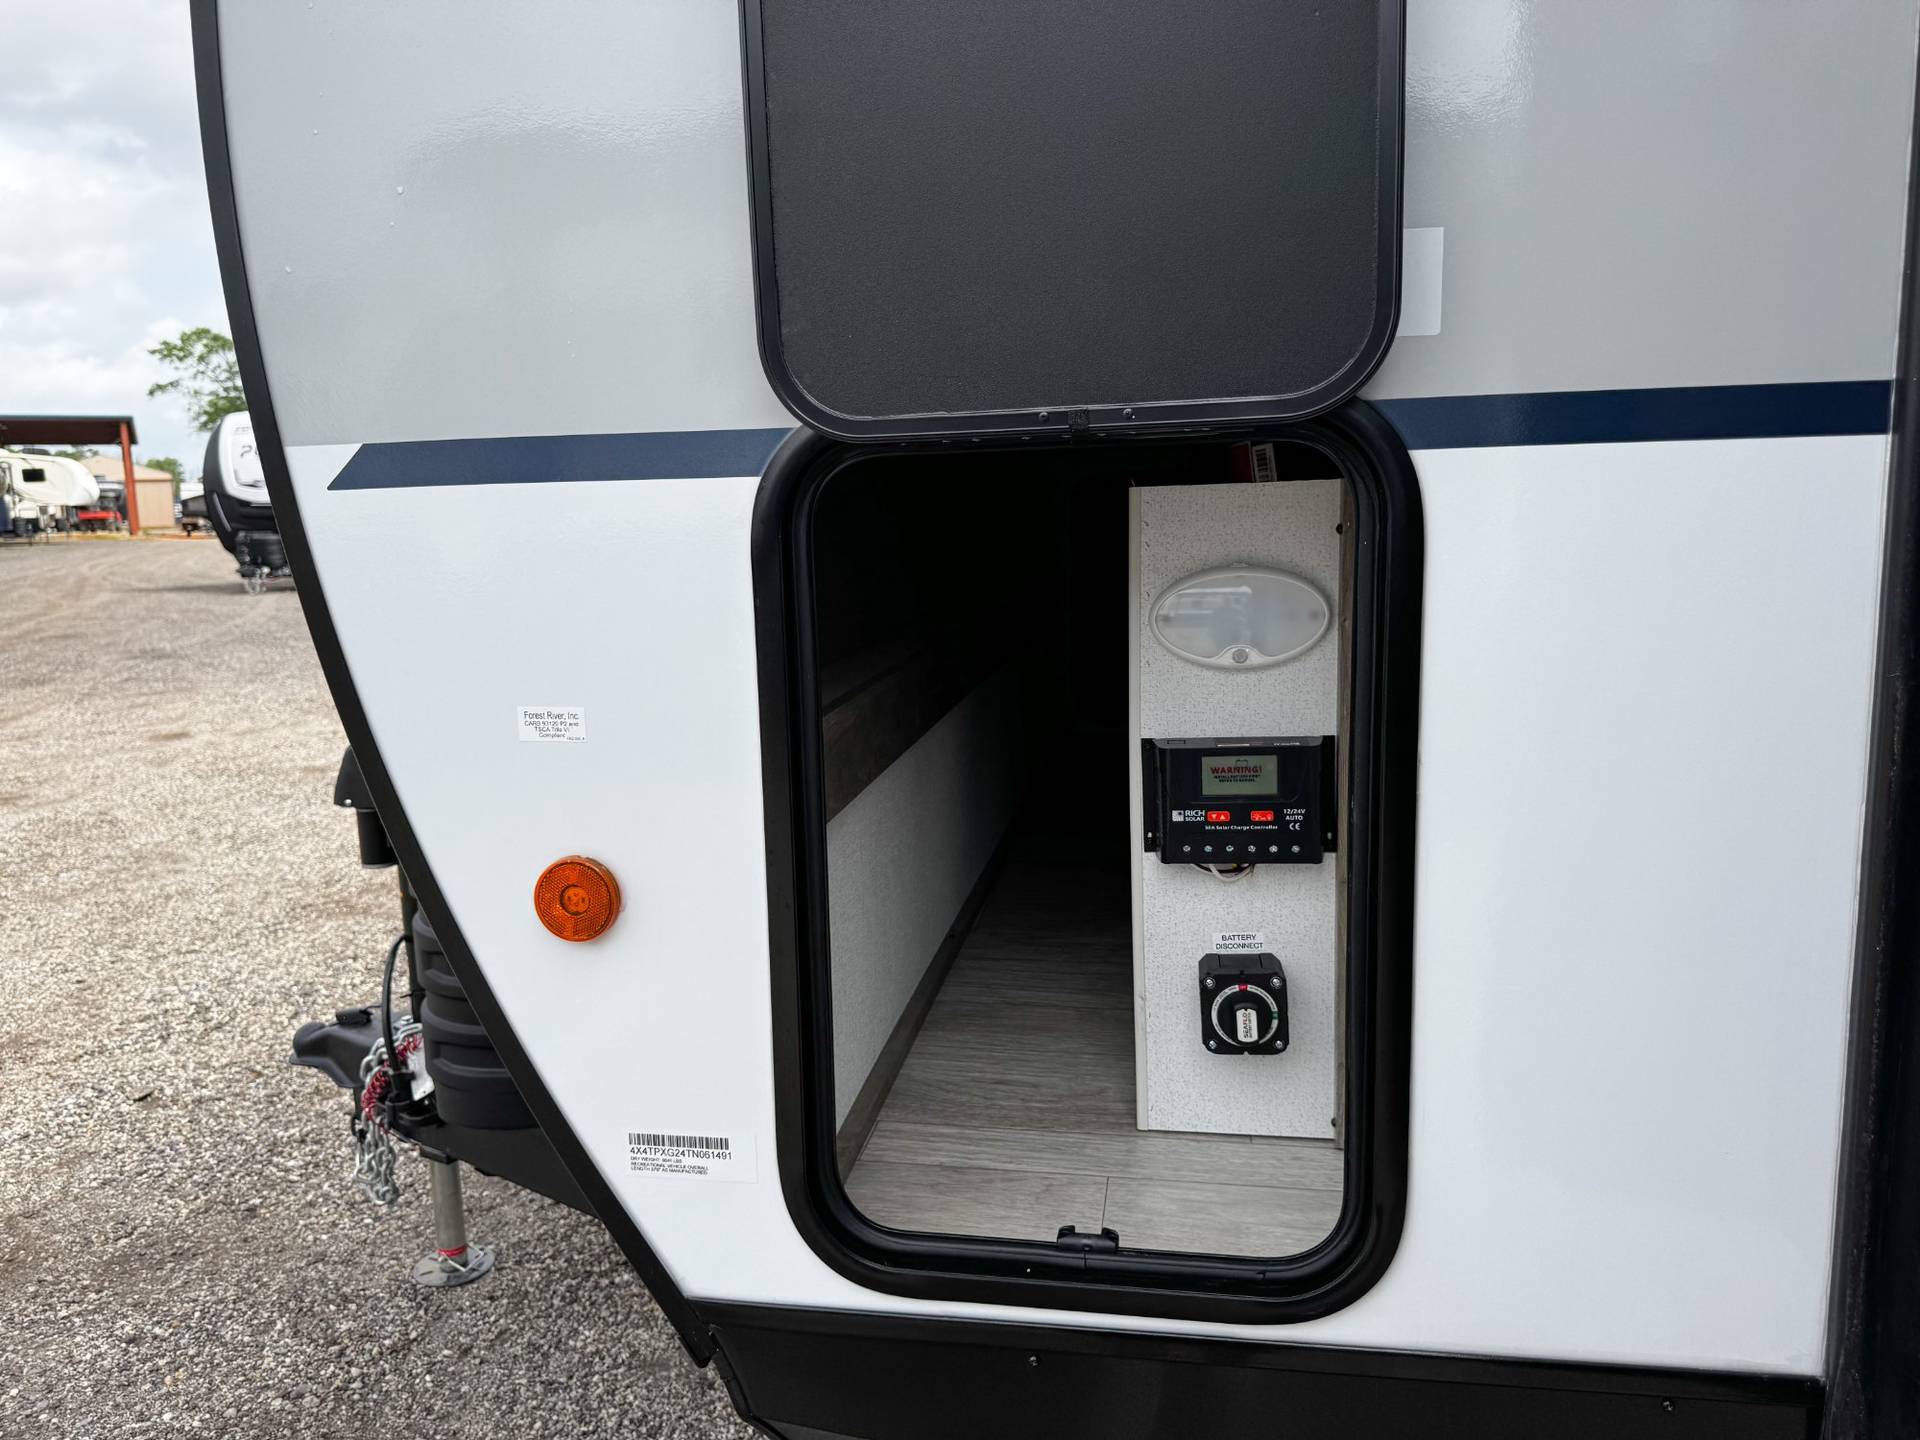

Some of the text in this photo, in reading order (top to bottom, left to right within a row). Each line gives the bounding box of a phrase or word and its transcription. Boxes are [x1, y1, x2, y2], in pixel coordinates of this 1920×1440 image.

[523, 710, 545, 719] Forest
[547, 710, 566, 720] River,
[1210, 766, 1262, 774] WARNING!
[630, 1146, 732, 1160] 4X4TPXG24TN061491
